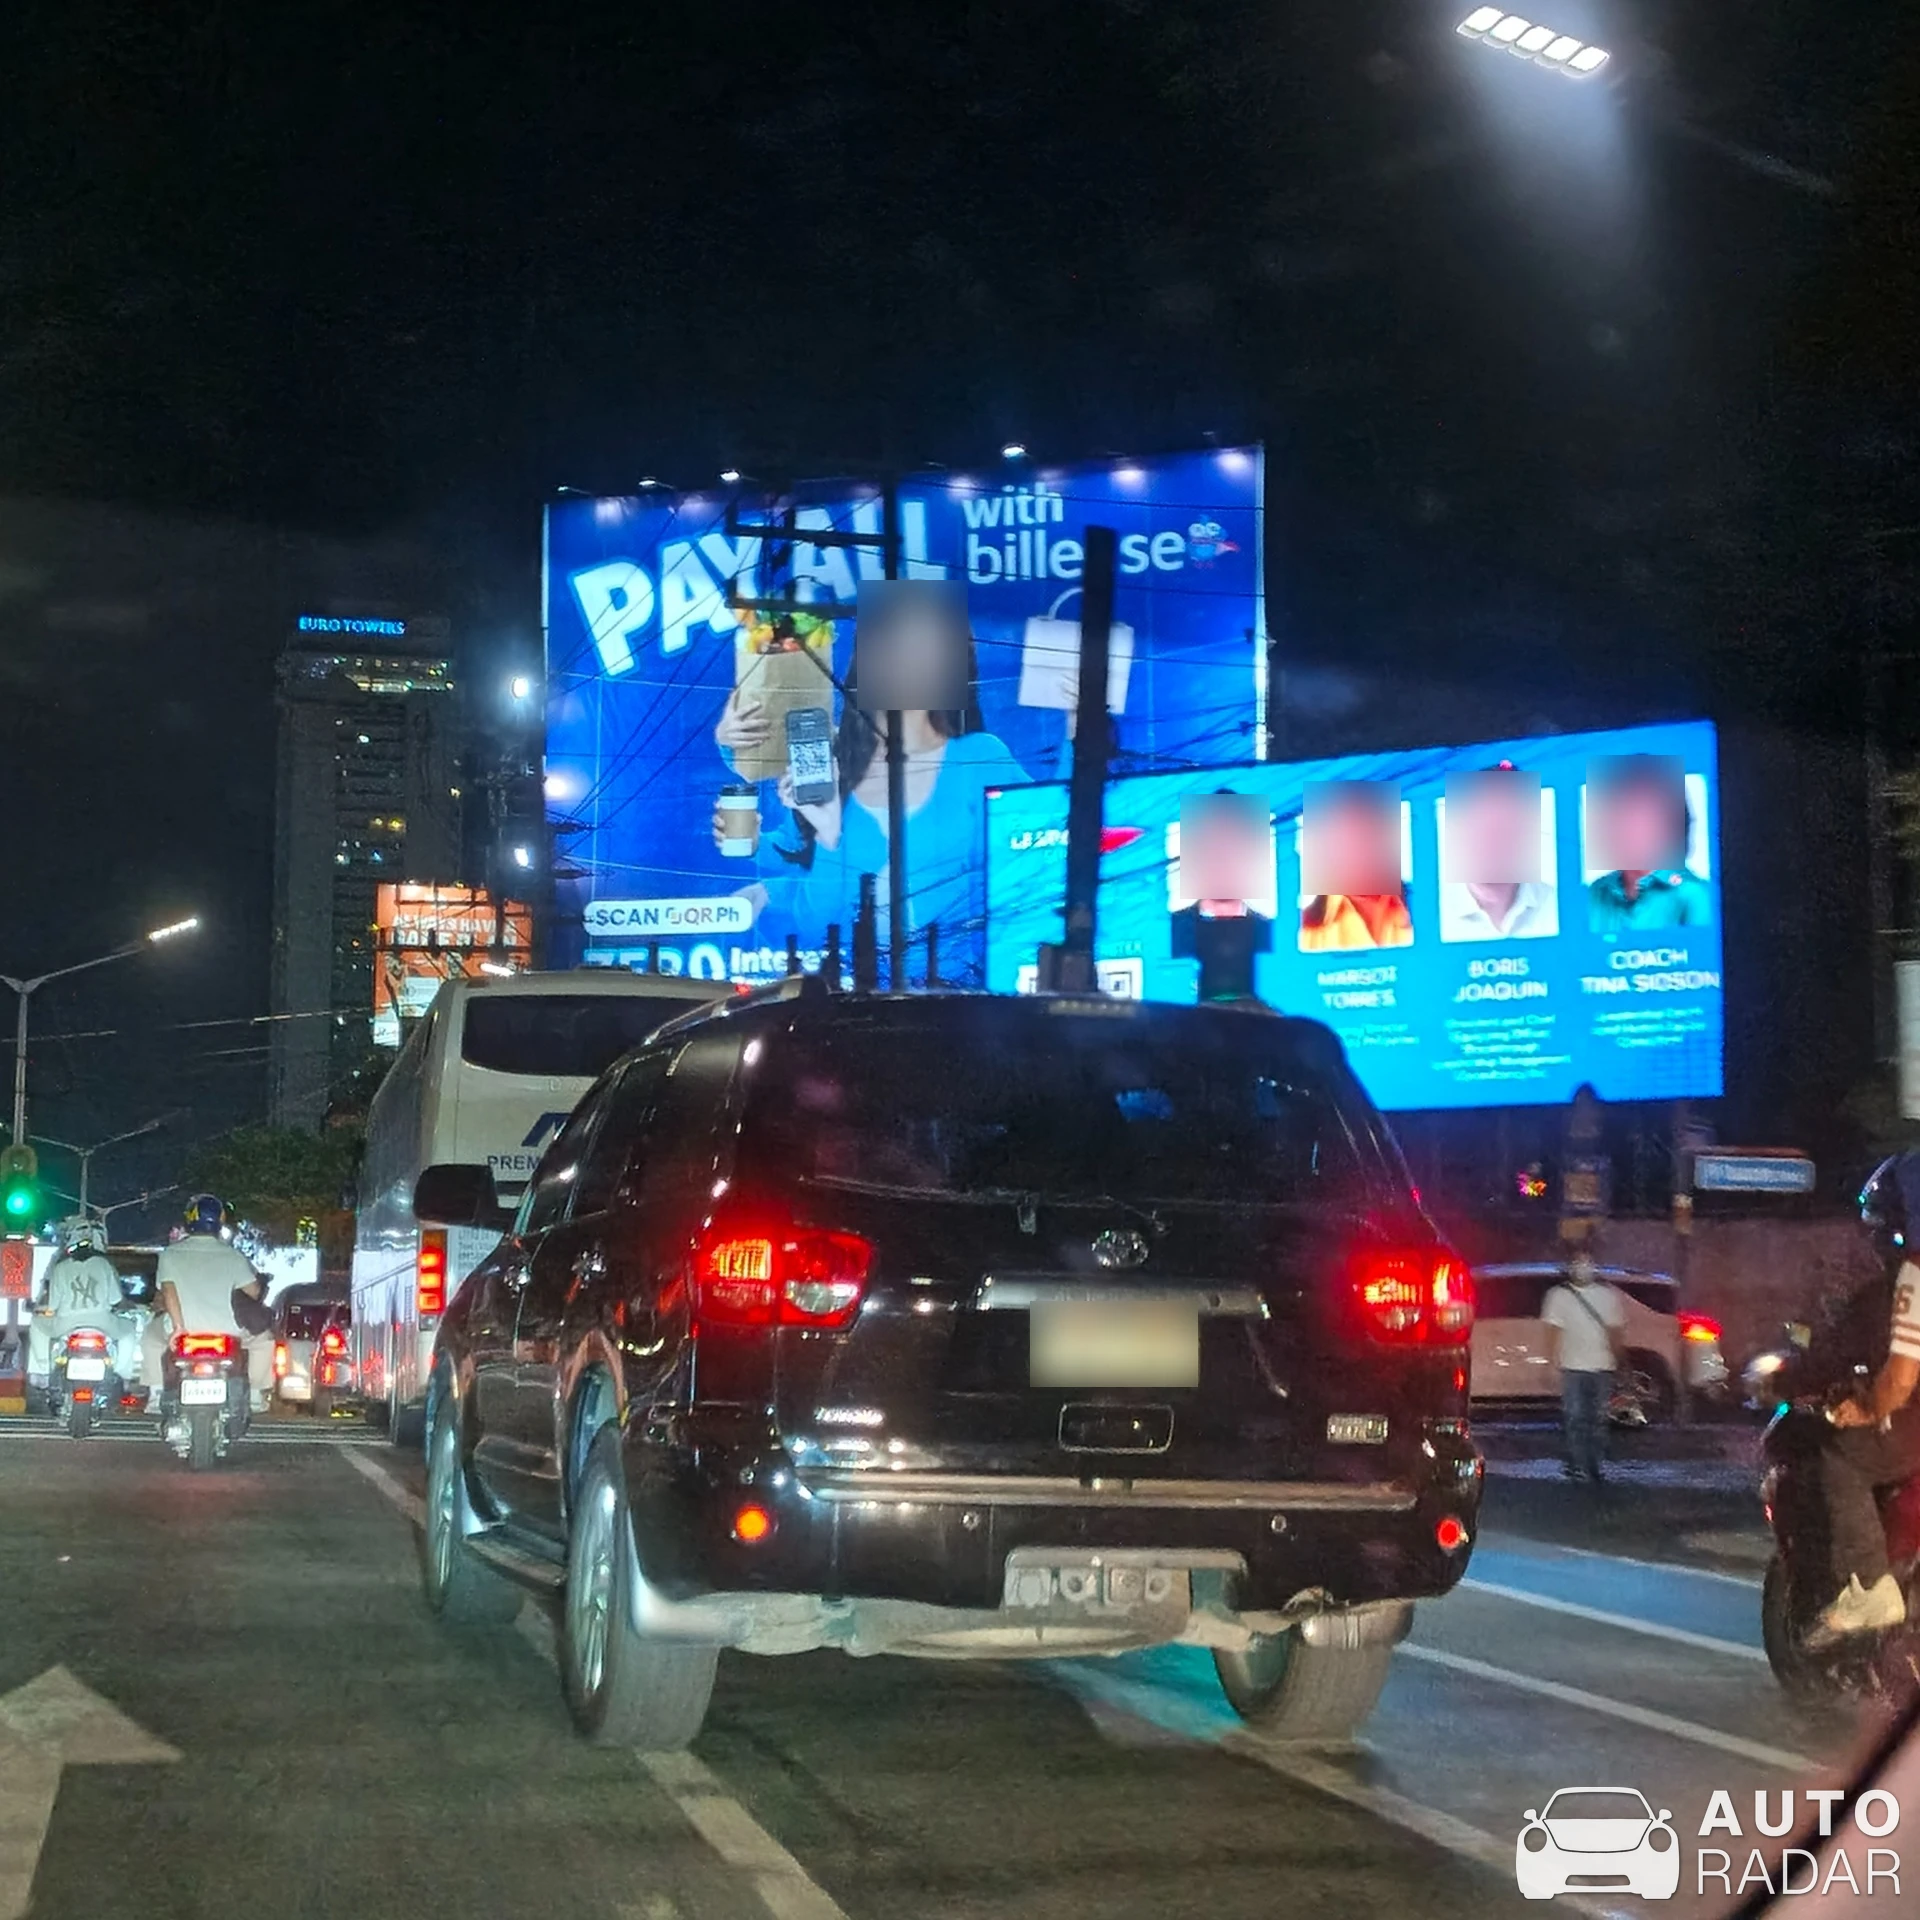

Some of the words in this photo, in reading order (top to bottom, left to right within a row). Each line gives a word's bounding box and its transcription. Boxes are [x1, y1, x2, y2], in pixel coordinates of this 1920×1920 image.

[962, 481, 1065, 529] with
[966, 528, 1186, 584] billese
[573, 532, 766, 677] PAY
[299, 616, 341, 632] EURO
[342, 618, 406, 635] TOWERS
[596, 907, 659, 927] SCAN
[730, 946, 848, 974] Intee
[1467, 957, 1530, 978] BORIS
[1609, 948, 1688, 970] COACH
[1453, 981, 1549, 1003] JOAQUIN
